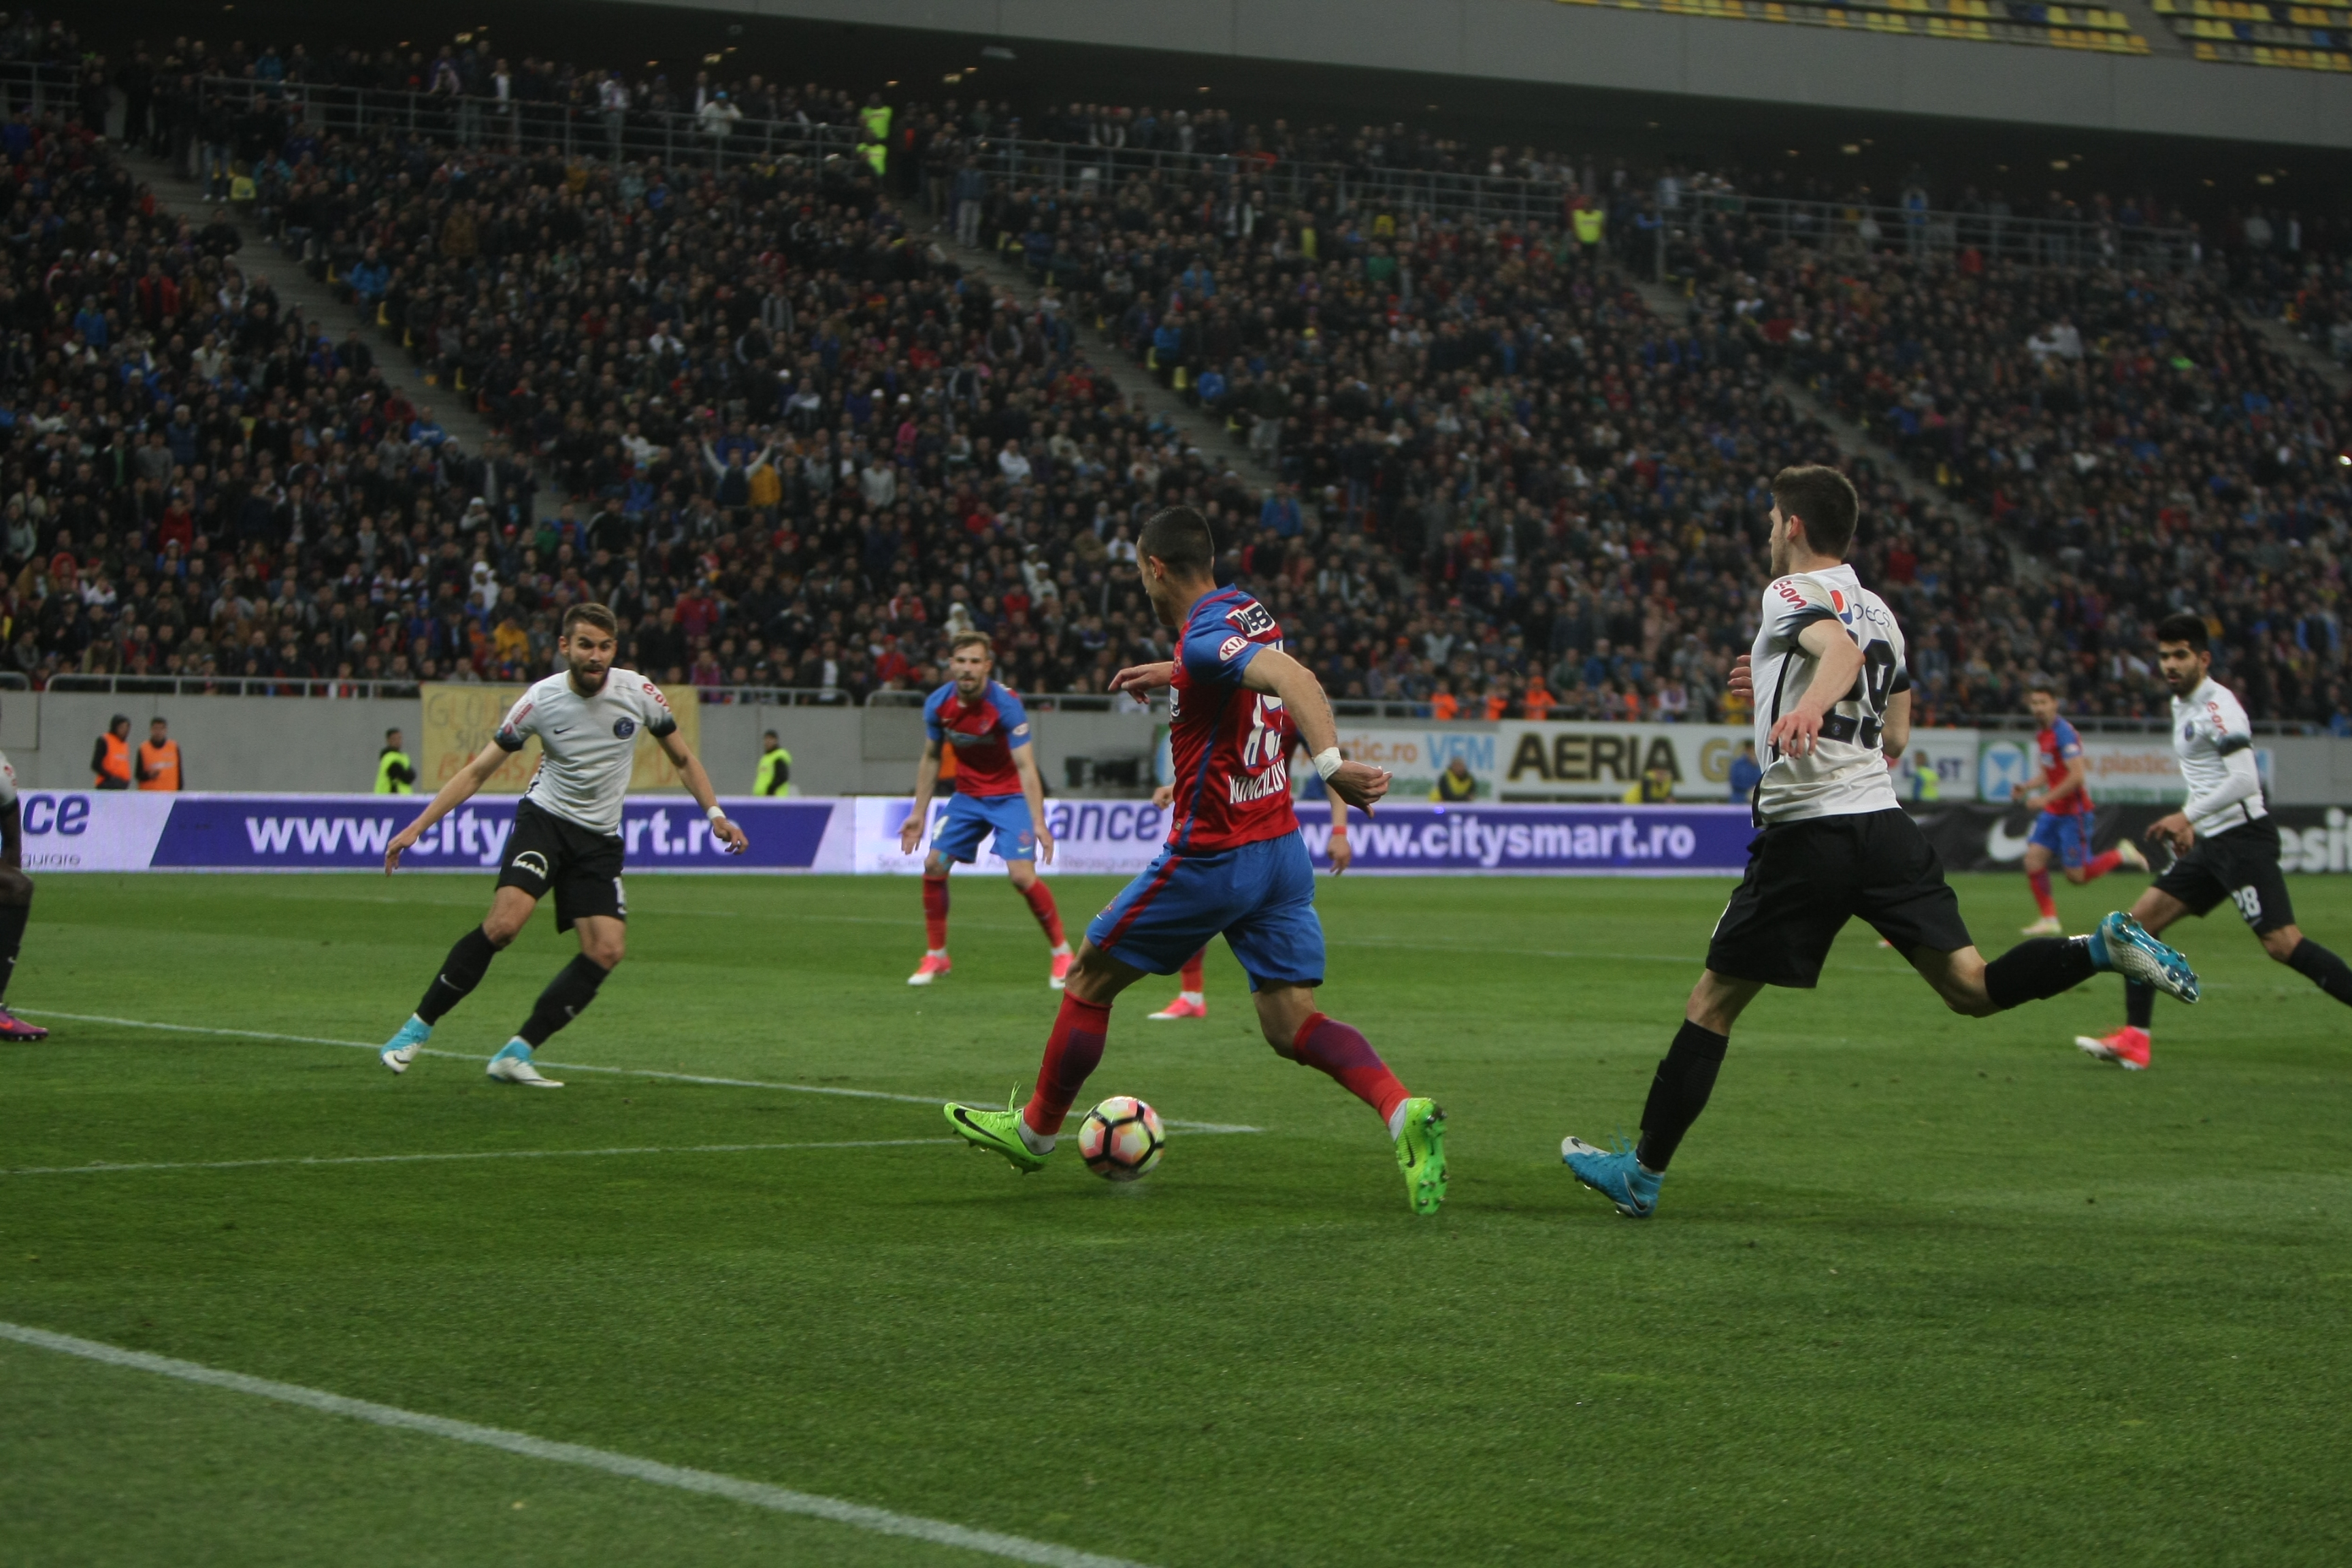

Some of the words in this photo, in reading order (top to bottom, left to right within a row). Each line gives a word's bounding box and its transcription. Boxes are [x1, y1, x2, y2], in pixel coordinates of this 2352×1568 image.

[1222, 638, 1243, 656] KIA
[1425, 733, 1496, 772] VFM
[1506, 732, 1684, 783] AERIA
[22, 794, 91, 836] ce
